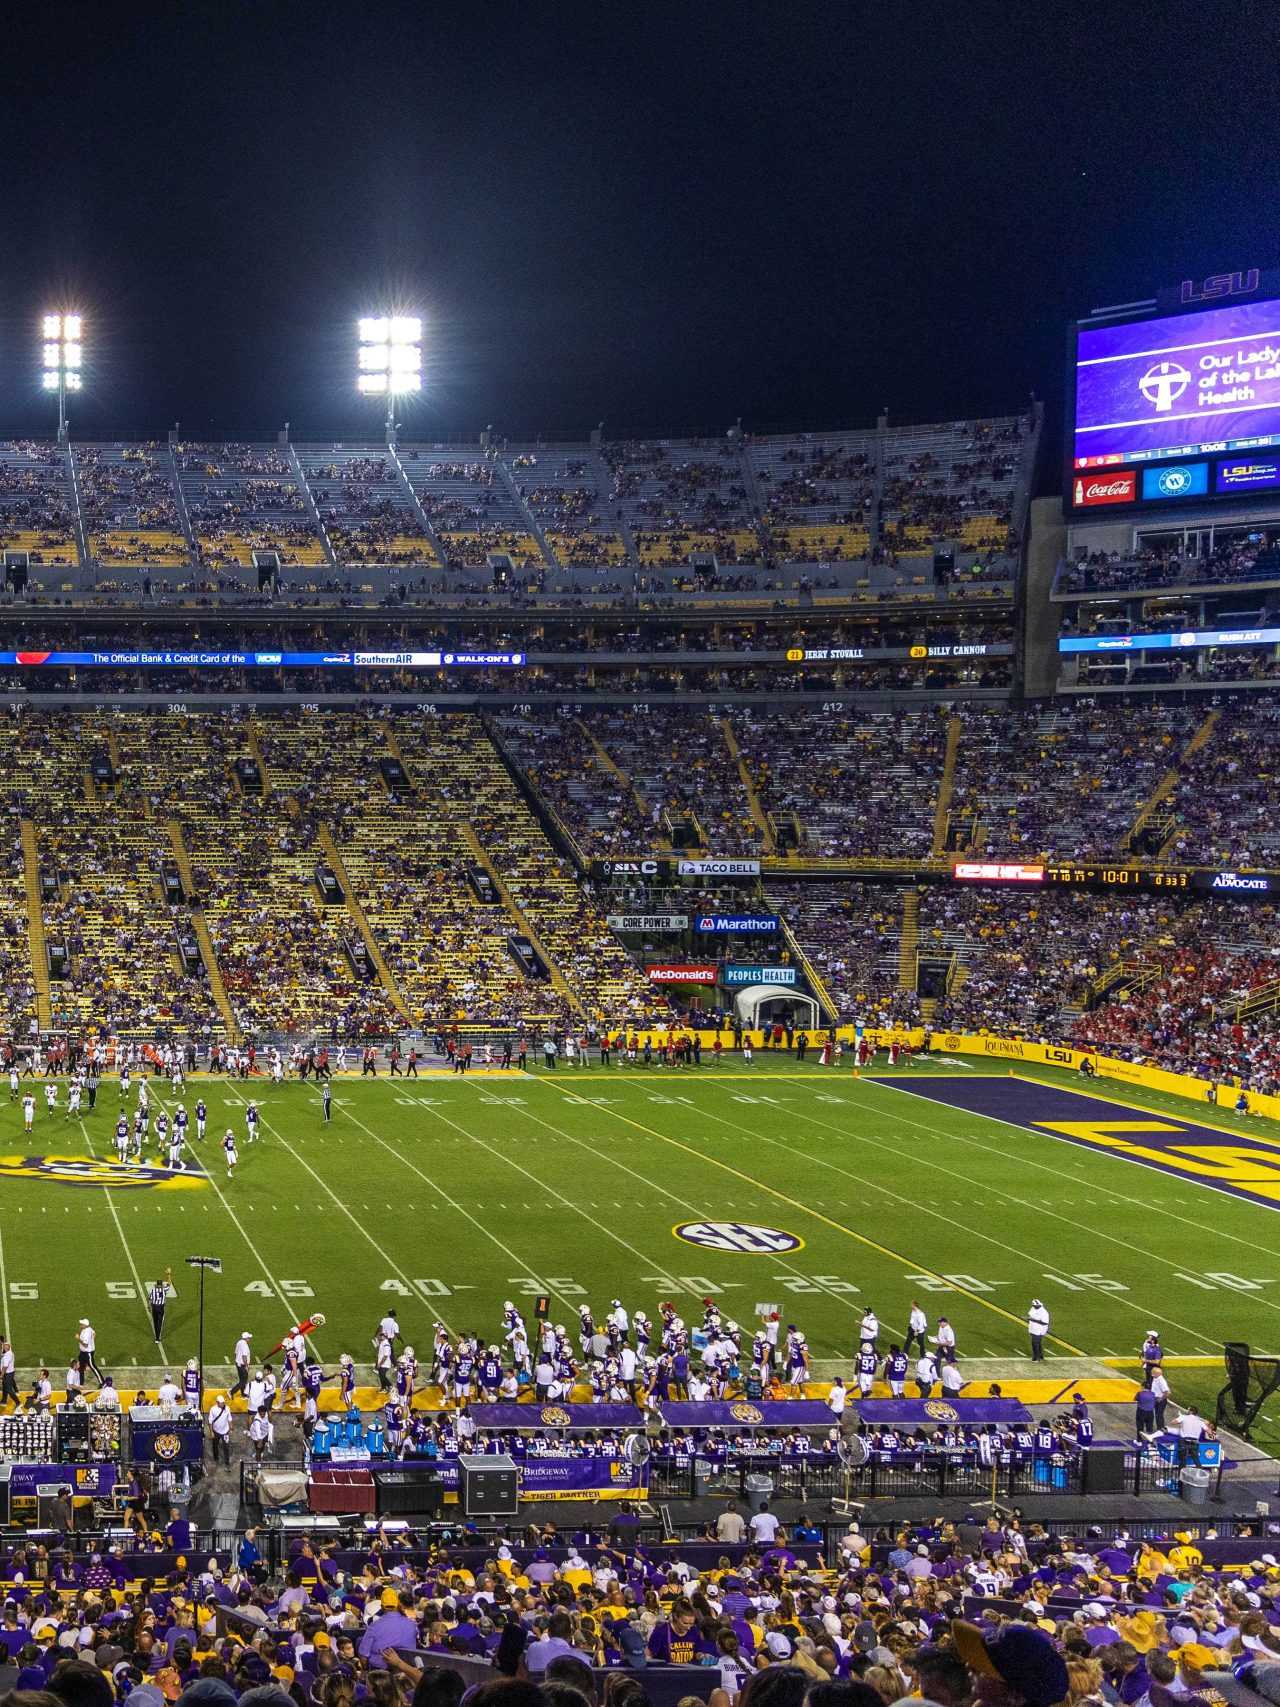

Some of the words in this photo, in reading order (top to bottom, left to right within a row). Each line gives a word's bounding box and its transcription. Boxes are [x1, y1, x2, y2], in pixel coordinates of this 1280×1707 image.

[1181, 268, 1260, 304] LSU
[1200, 355, 1233, 370] Our
[1238, 346, 1280, 366] Lady
[1199, 371, 1219, 388] of
[1222, 369, 1250, 385] the
[1199, 386, 1255, 406] Health
[1086, 480, 1134, 498] Coca-Cola
[805, 650, 828, 659] JERRY
[831, 649, 864, 658] STOVALL
[928, 647, 950, 656] BILLY
[953, 645, 986, 655] CANNON
[94, 654, 109, 663] The
[111, 654, 139, 663] Official
[142, 654, 163, 663] Bank
[165, 654, 171, 663] &
[174, 654, 198, 663] Credit
[201, 654, 219, 663] Card
[222, 654, 230, 663] of
[232, 654, 245, 663] the
[355, 655, 413, 664] SouthernAIR
[168, 703, 186, 713] 304
[822, 702, 842, 711] 412
[700, 864, 727, 873] TACO
[729, 864, 755, 873] BELL
[1061, 874, 1071, 882] 10
[1156, 877, 1162, 885] 0
[1166, 878, 1177, 886] 33
[1181, 877, 1186, 886] 3
[1213, 877, 1267, 889] ADVOCATE
[623, 917, 642, 928] CORE
[644, 917, 671, 928] POWER
[717, 919, 776, 930] Marathon
[650, 970, 714, 980] McDonald's
[728, 971, 761, 981] PEOPLES
[764, 971, 794, 981] HEALTH
[985, 1039, 1024, 1057] LOUISIANA
[1045, 1049, 1072, 1064] LSU
[394, 1098, 442, 1106] 30
[479, 1097, 528, 1105] 25
[649, 1096, 695, 1104] 15
[731, 1096, 780, 1104] 10
[1029, 1121, 1280, 1202] LS
[682, 1223, 795, 1252] SEC
[508, 1278, 588, 1296] 35
[640, 1277, 725, 1294] 30
[773, 1276, 861, 1292] 25
[904, 1275, 995, 1292] 20
[1042, 1274, 1130, 1290] 15
[1172, 1273, 1264, 1290] 10
[243, 1280, 315, 1298] 45
[379, 1279, 452, 1297] 40
[862, 1360, 874, 1371] 94
[894, 1360, 907, 1371] 95
[486, 1366, 497, 1378] 91
[186, 1377, 197, 1388] 31
[1081, 1425, 1092, 1436] 17
[445, 1440, 458, 1452] 26
[494, 1441, 500, 1454] 1
[795, 1441, 809, 1454] 33
[882, 1438, 897, 1448] 92
[1018, 1437, 1033, 1447] 90
[1039, 1436, 1051, 1448] 18
[524, 1467, 569, 1476] BRIDGEWAY
[585, 1534, 589, 1544] 1
[987, 1583, 995, 1596] 9
